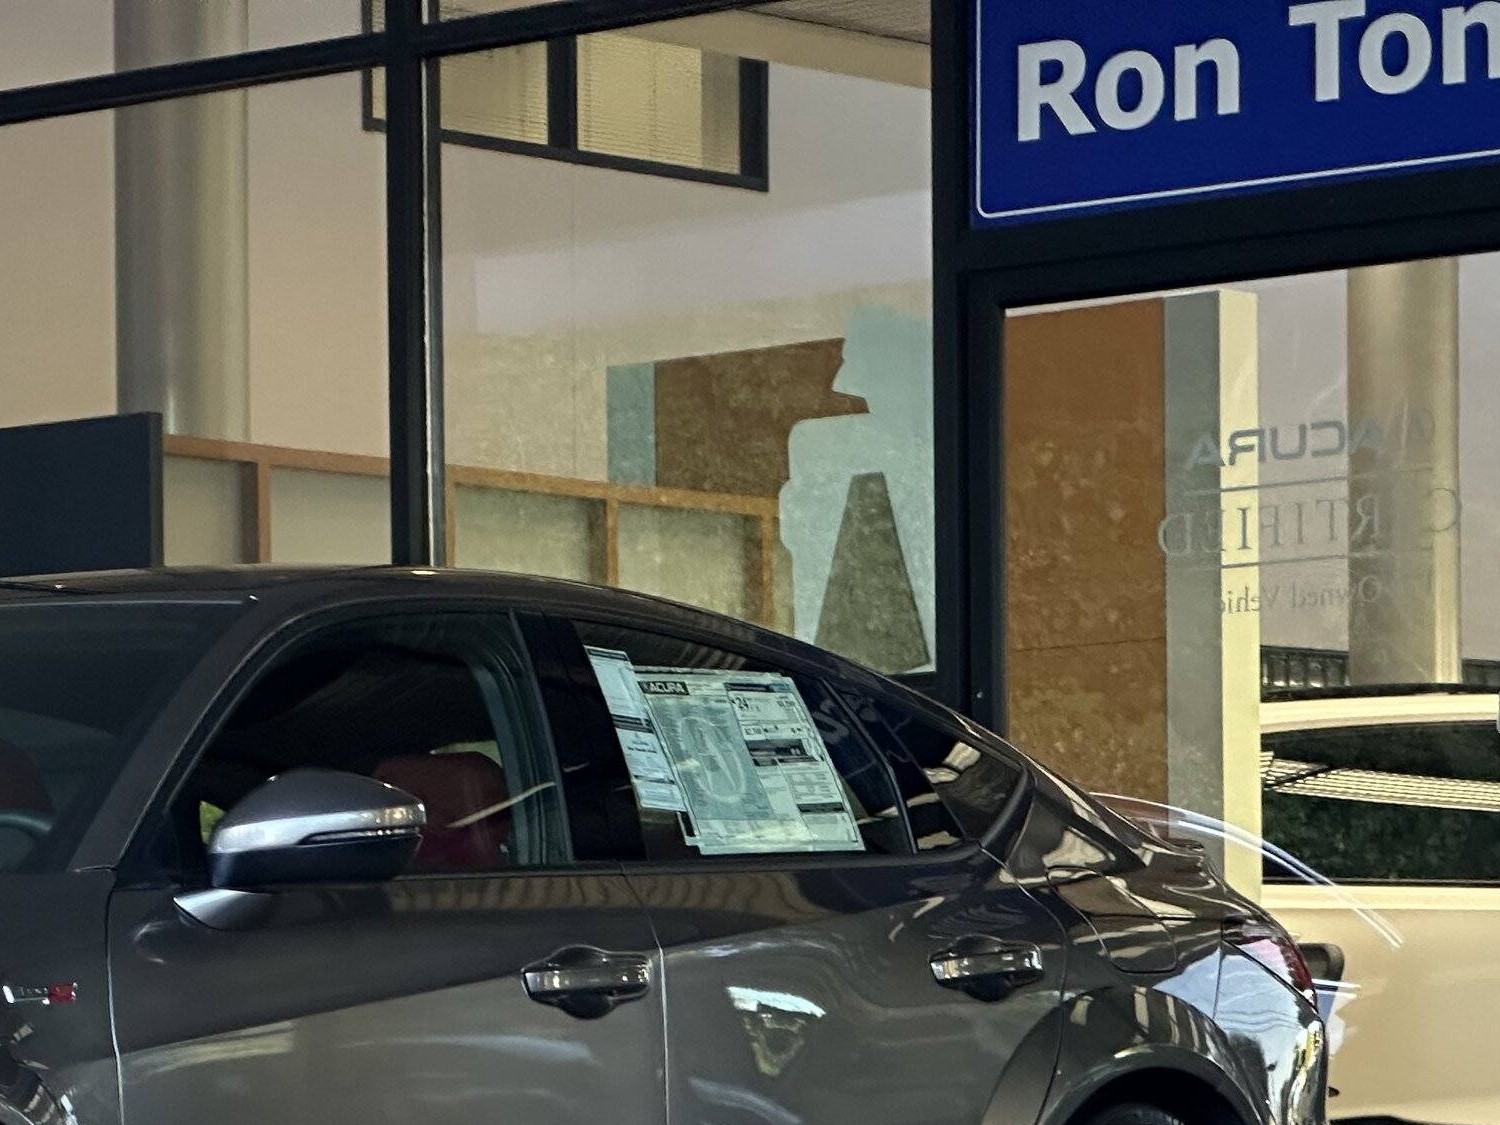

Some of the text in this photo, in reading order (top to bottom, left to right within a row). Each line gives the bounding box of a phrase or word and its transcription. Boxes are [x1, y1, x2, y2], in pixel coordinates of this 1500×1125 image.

[1017, 0, 1500, 142] Ron Ton
[648, 681, 686, 694] ACURA
